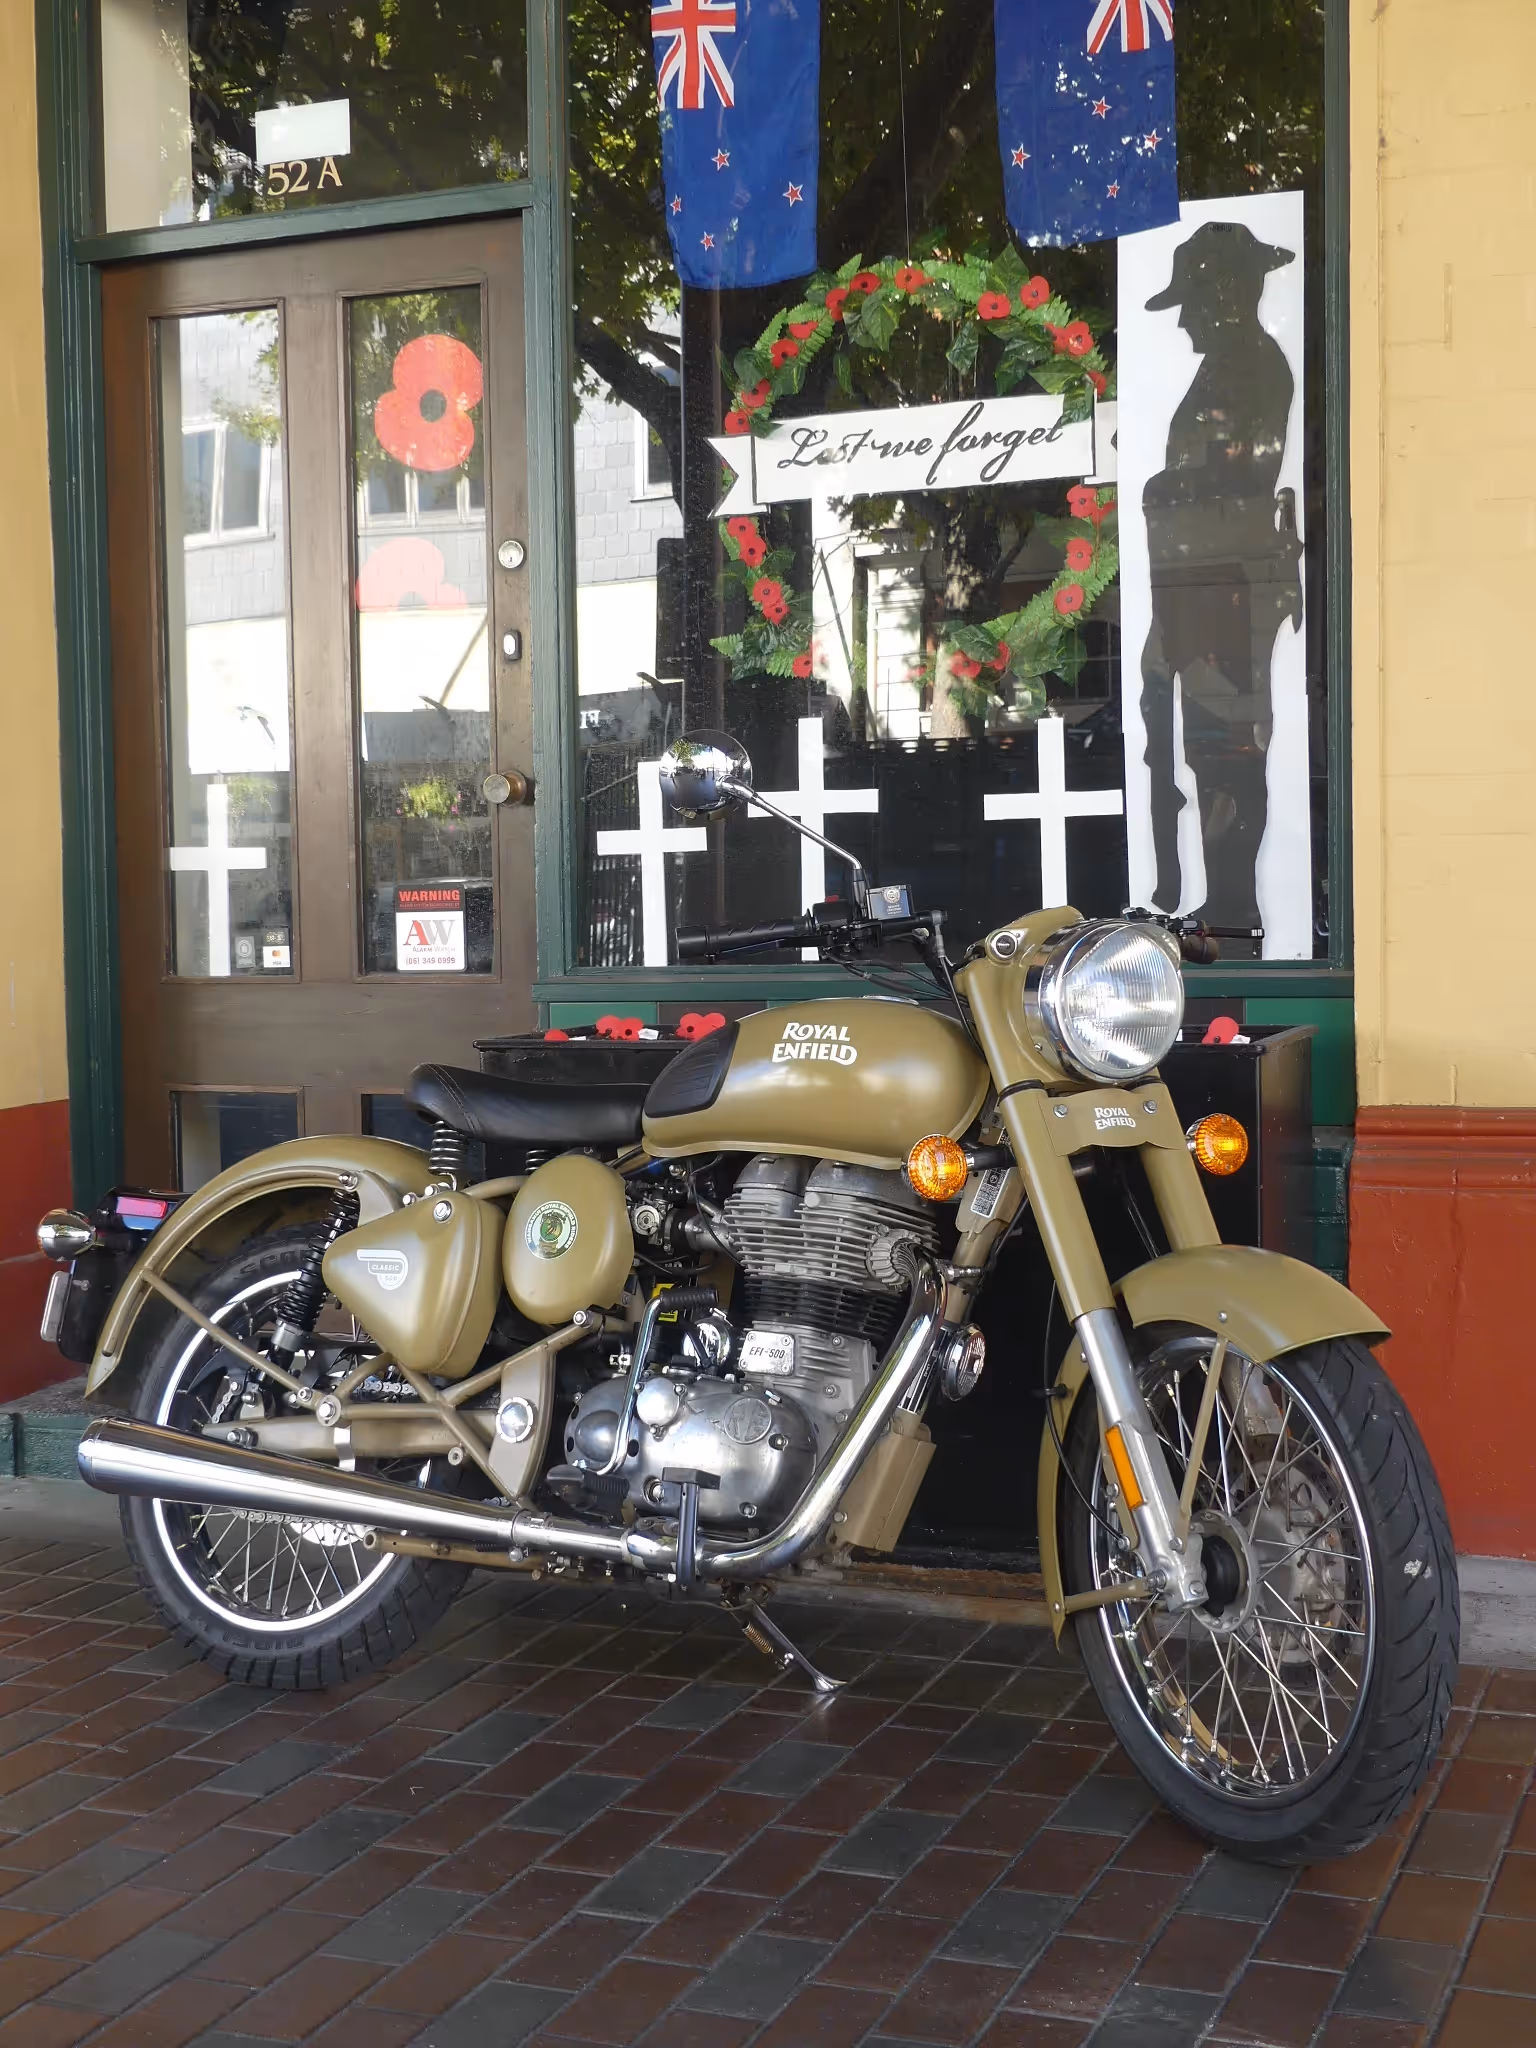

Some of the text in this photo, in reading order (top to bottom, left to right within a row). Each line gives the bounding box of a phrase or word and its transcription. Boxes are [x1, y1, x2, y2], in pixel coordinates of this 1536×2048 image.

[267, 156, 343, 196] 52 A
[777, 401, 1064, 485] Lest we forget
[399, 890, 460, 902] WARNING
[403, 919, 456, 946] AW
[782, 1022, 851, 1041] ROYAL
[771, 1043, 858, 1066] ENFIELD
[1094, 1107, 1130, 1118] ROYAL
[1094, 1117, 1136, 1130] ENFIELD
[540, 1203, 560, 1212] ROYAL
